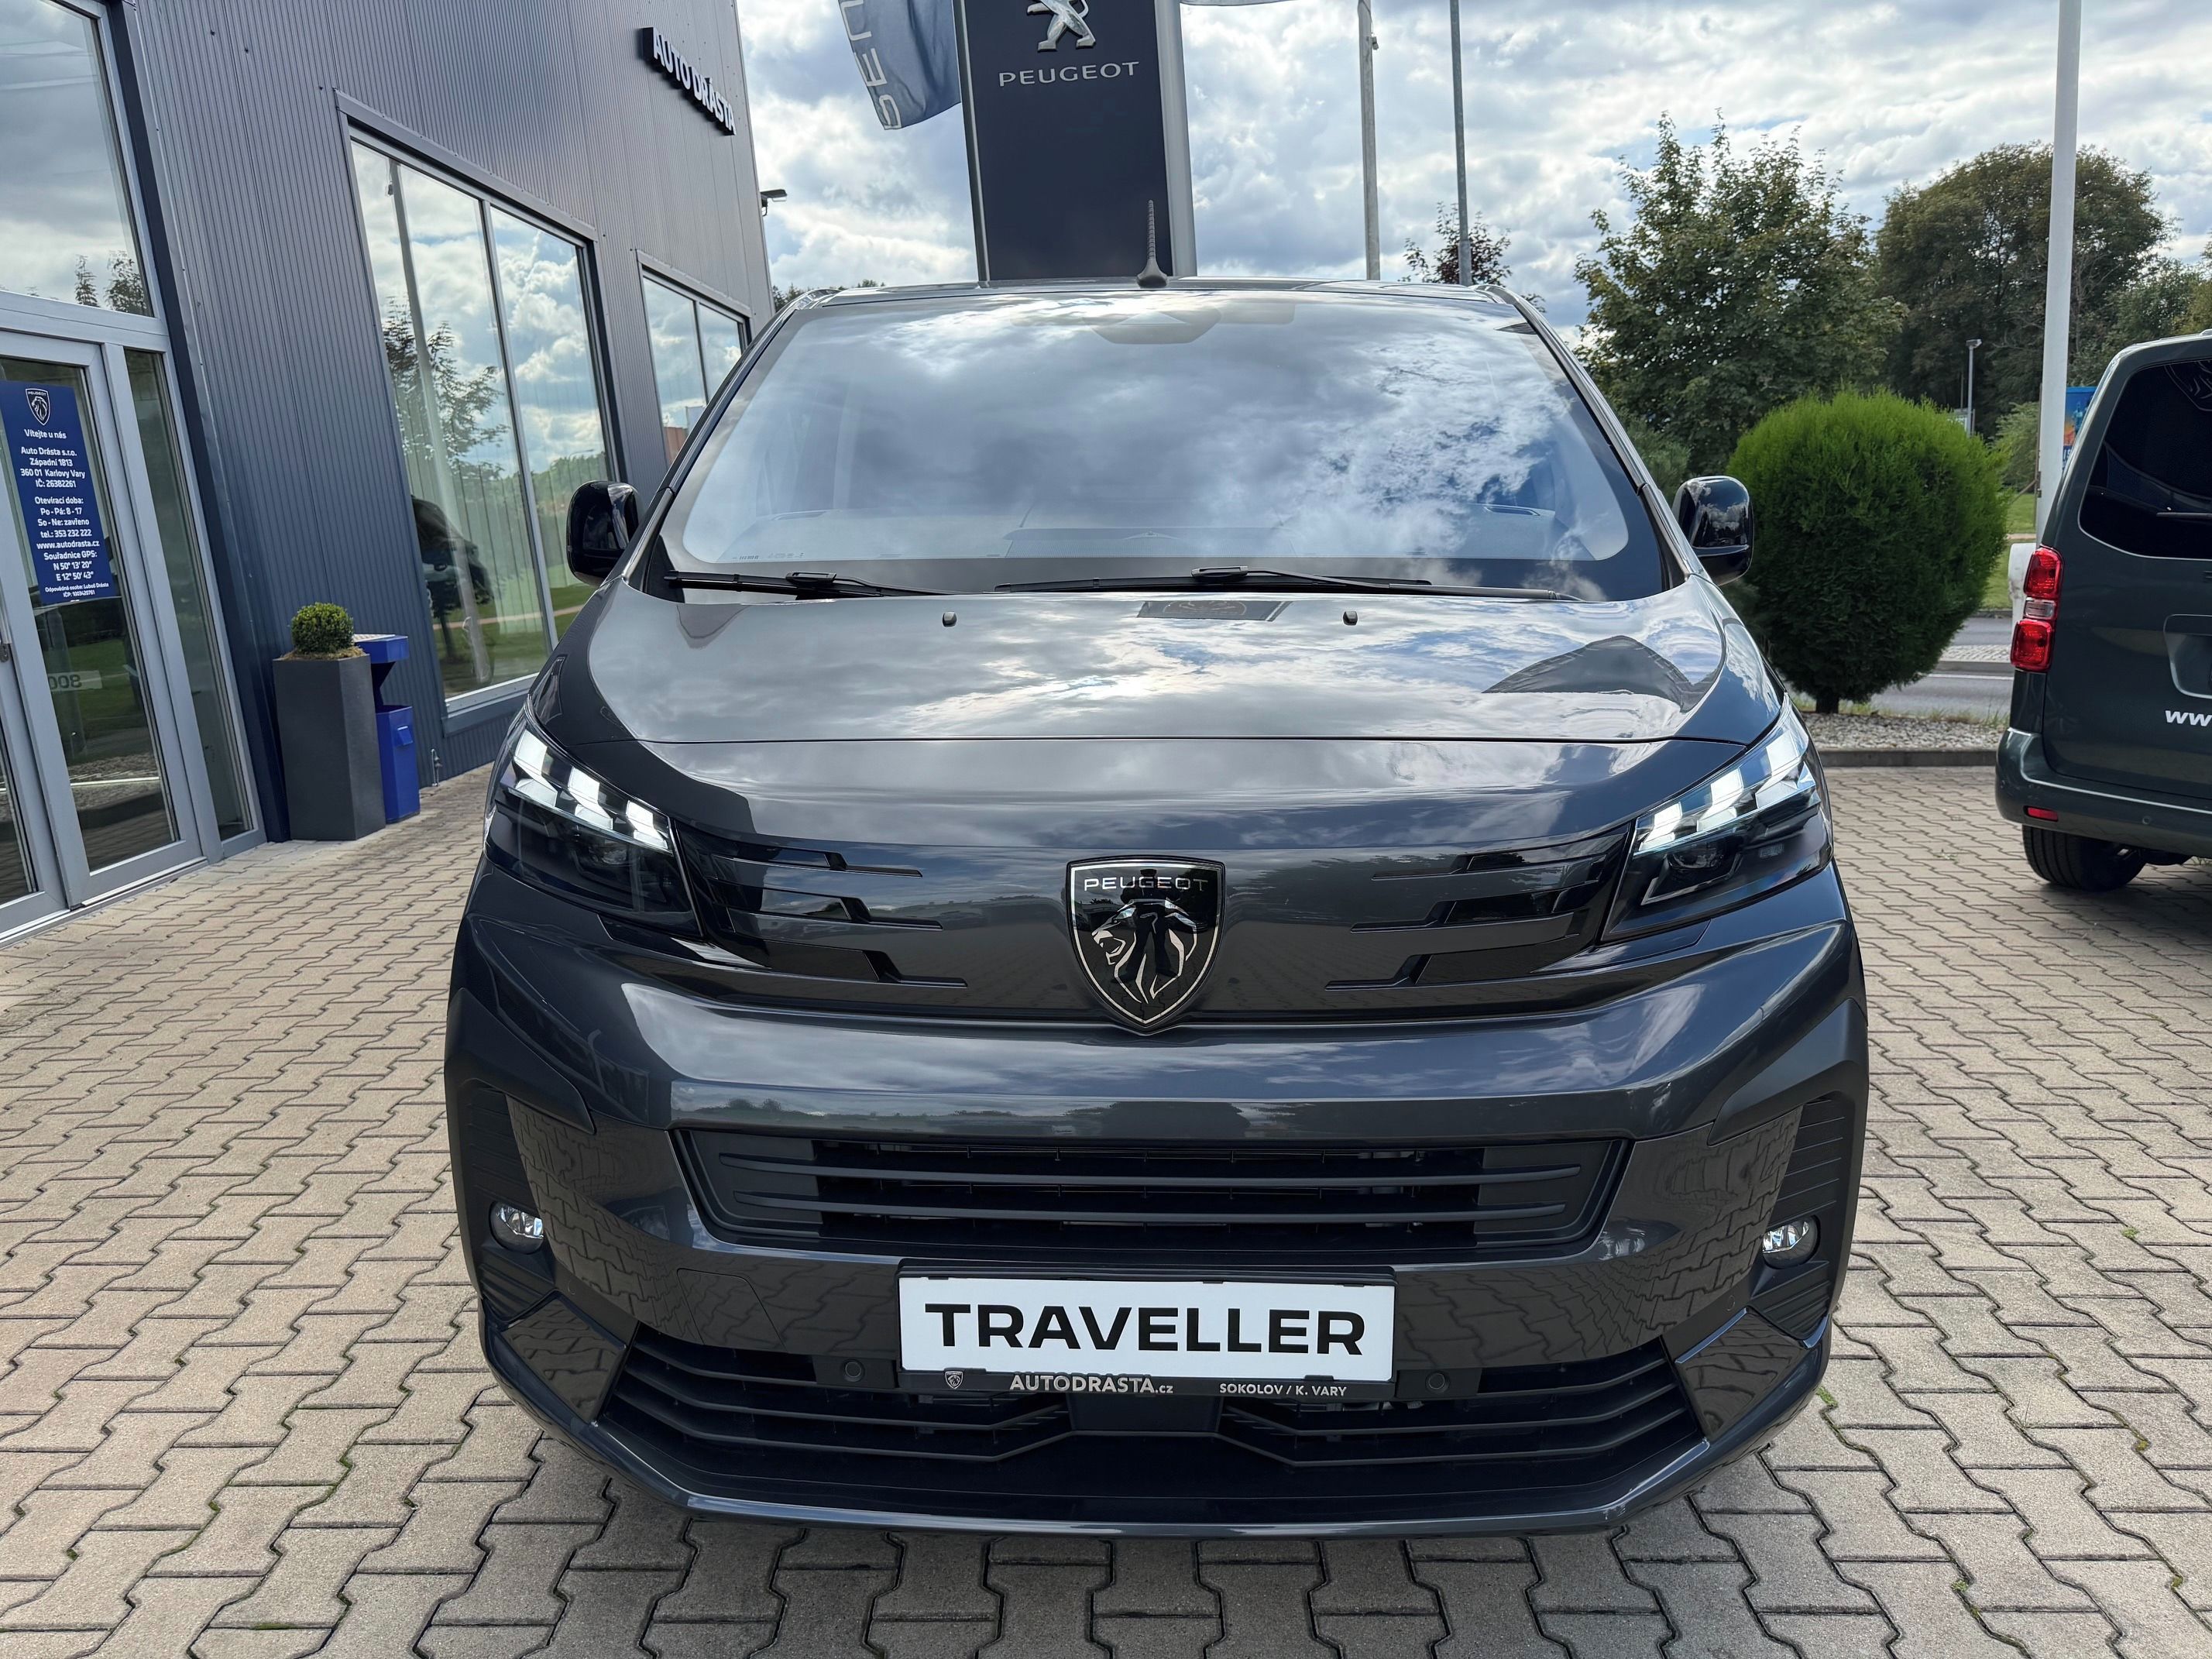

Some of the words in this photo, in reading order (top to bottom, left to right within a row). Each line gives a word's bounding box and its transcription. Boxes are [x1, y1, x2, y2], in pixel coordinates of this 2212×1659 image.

[998, 61, 1139, 87] PEUGEOT
[653, 26, 691, 90] AUTO
[691, 66, 737, 136] DRÁSTA
[24, 429, 47, 439] Vítejte
[54, 431, 67, 439] nás
[39, 447, 60, 455] Drásta
[29, 458, 57, 467] Západní
[58, 459, 73, 467] 1813
[45, 469, 70, 479] Karlovy
[70, 469, 85, 479] Vary
[35, 478, 46, 487] IČ:
[35, 496, 64, 504] Otevírací
[37, 518, 47, 527] So
[68, 529, 79, 538] 232
[36, 541, 100, 549] www.autodrasta.cz
[43, 551, 81, 560] Souřadnice
[81, 550, 97, 558] GPS:
[2165, 710, 2212, 726] ww
[1084, 876, 1208, 891] PEUGEOT
[925, 1304, 1365, 1355] TRAVELLER
[1009, 1375, 1173, 1393] AUTODRASTA.cz
[1219, 1383, 1283, 1395] SOKOLOV
[1295, 1386, 1308, 1396] K.
[1312, 1386, 1347, 1396] VARY
